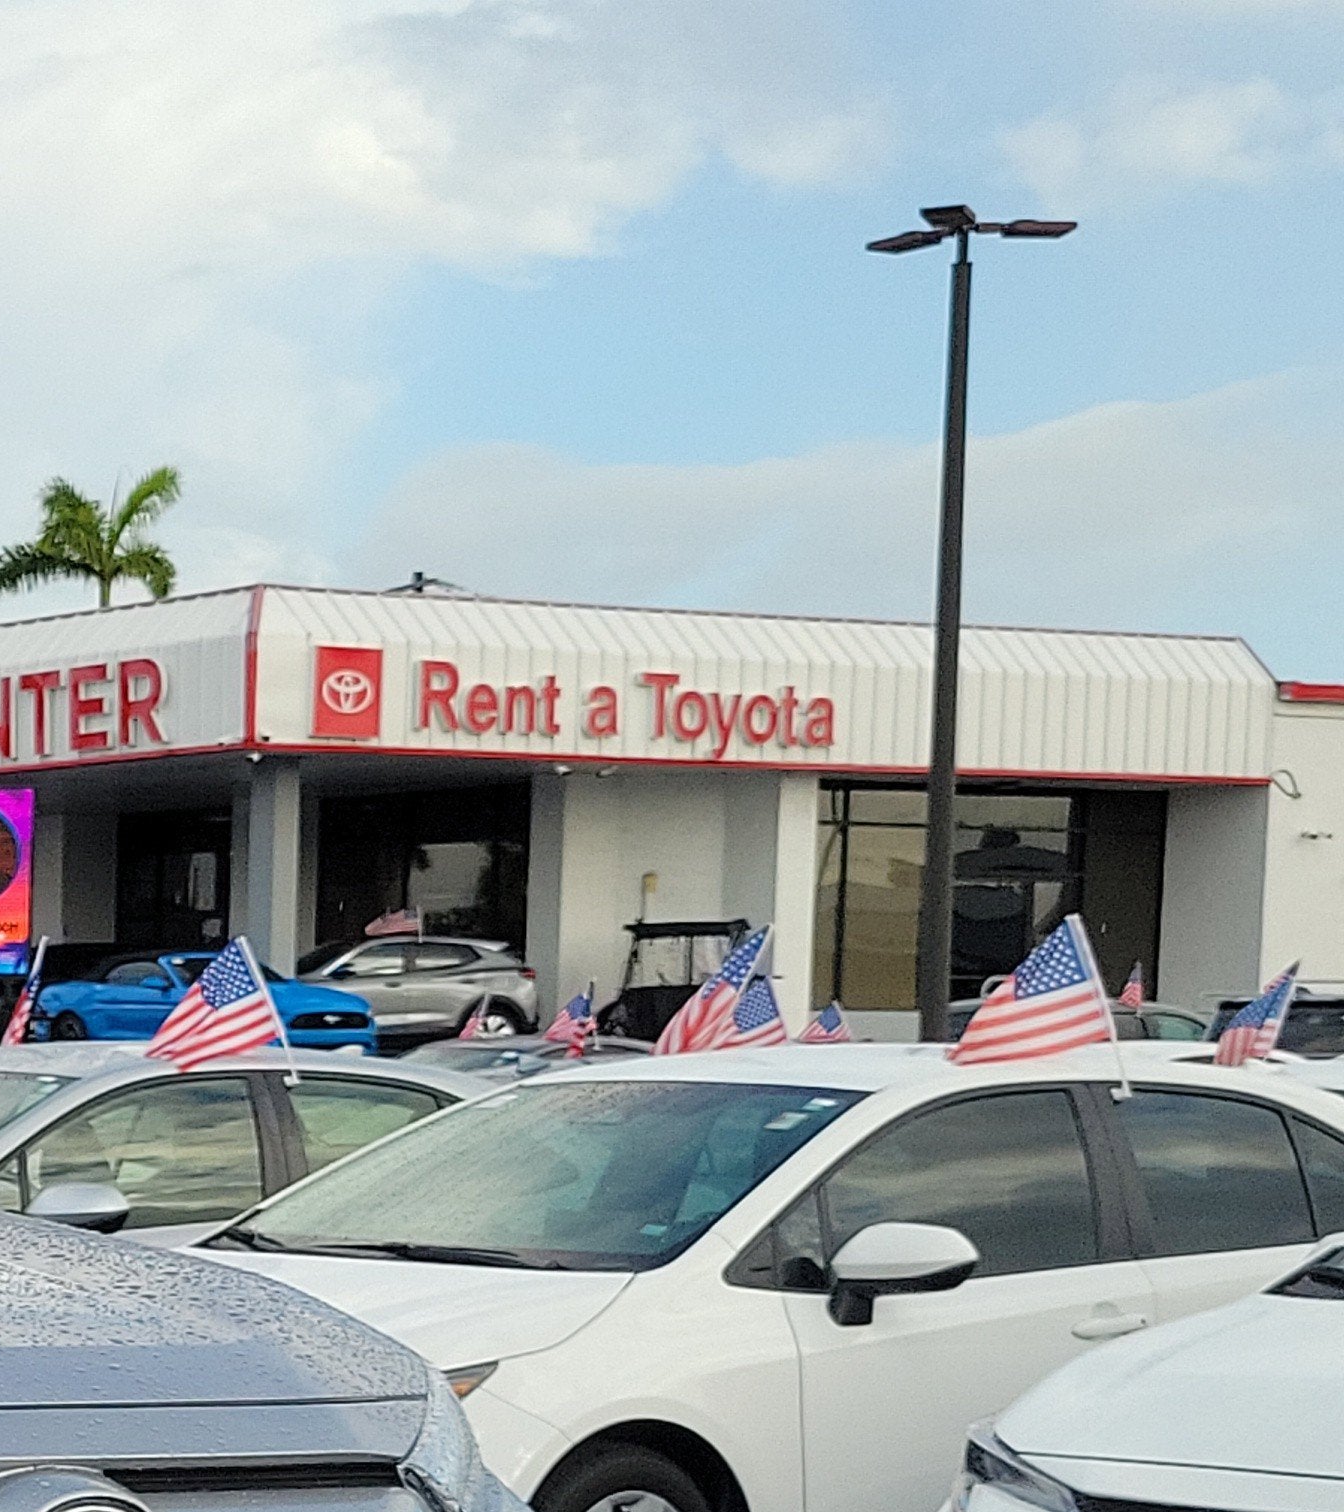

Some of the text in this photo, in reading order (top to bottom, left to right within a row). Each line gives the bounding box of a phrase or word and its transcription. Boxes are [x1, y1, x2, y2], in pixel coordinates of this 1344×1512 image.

[416, 659, 836, 760] Rent a Toyota
